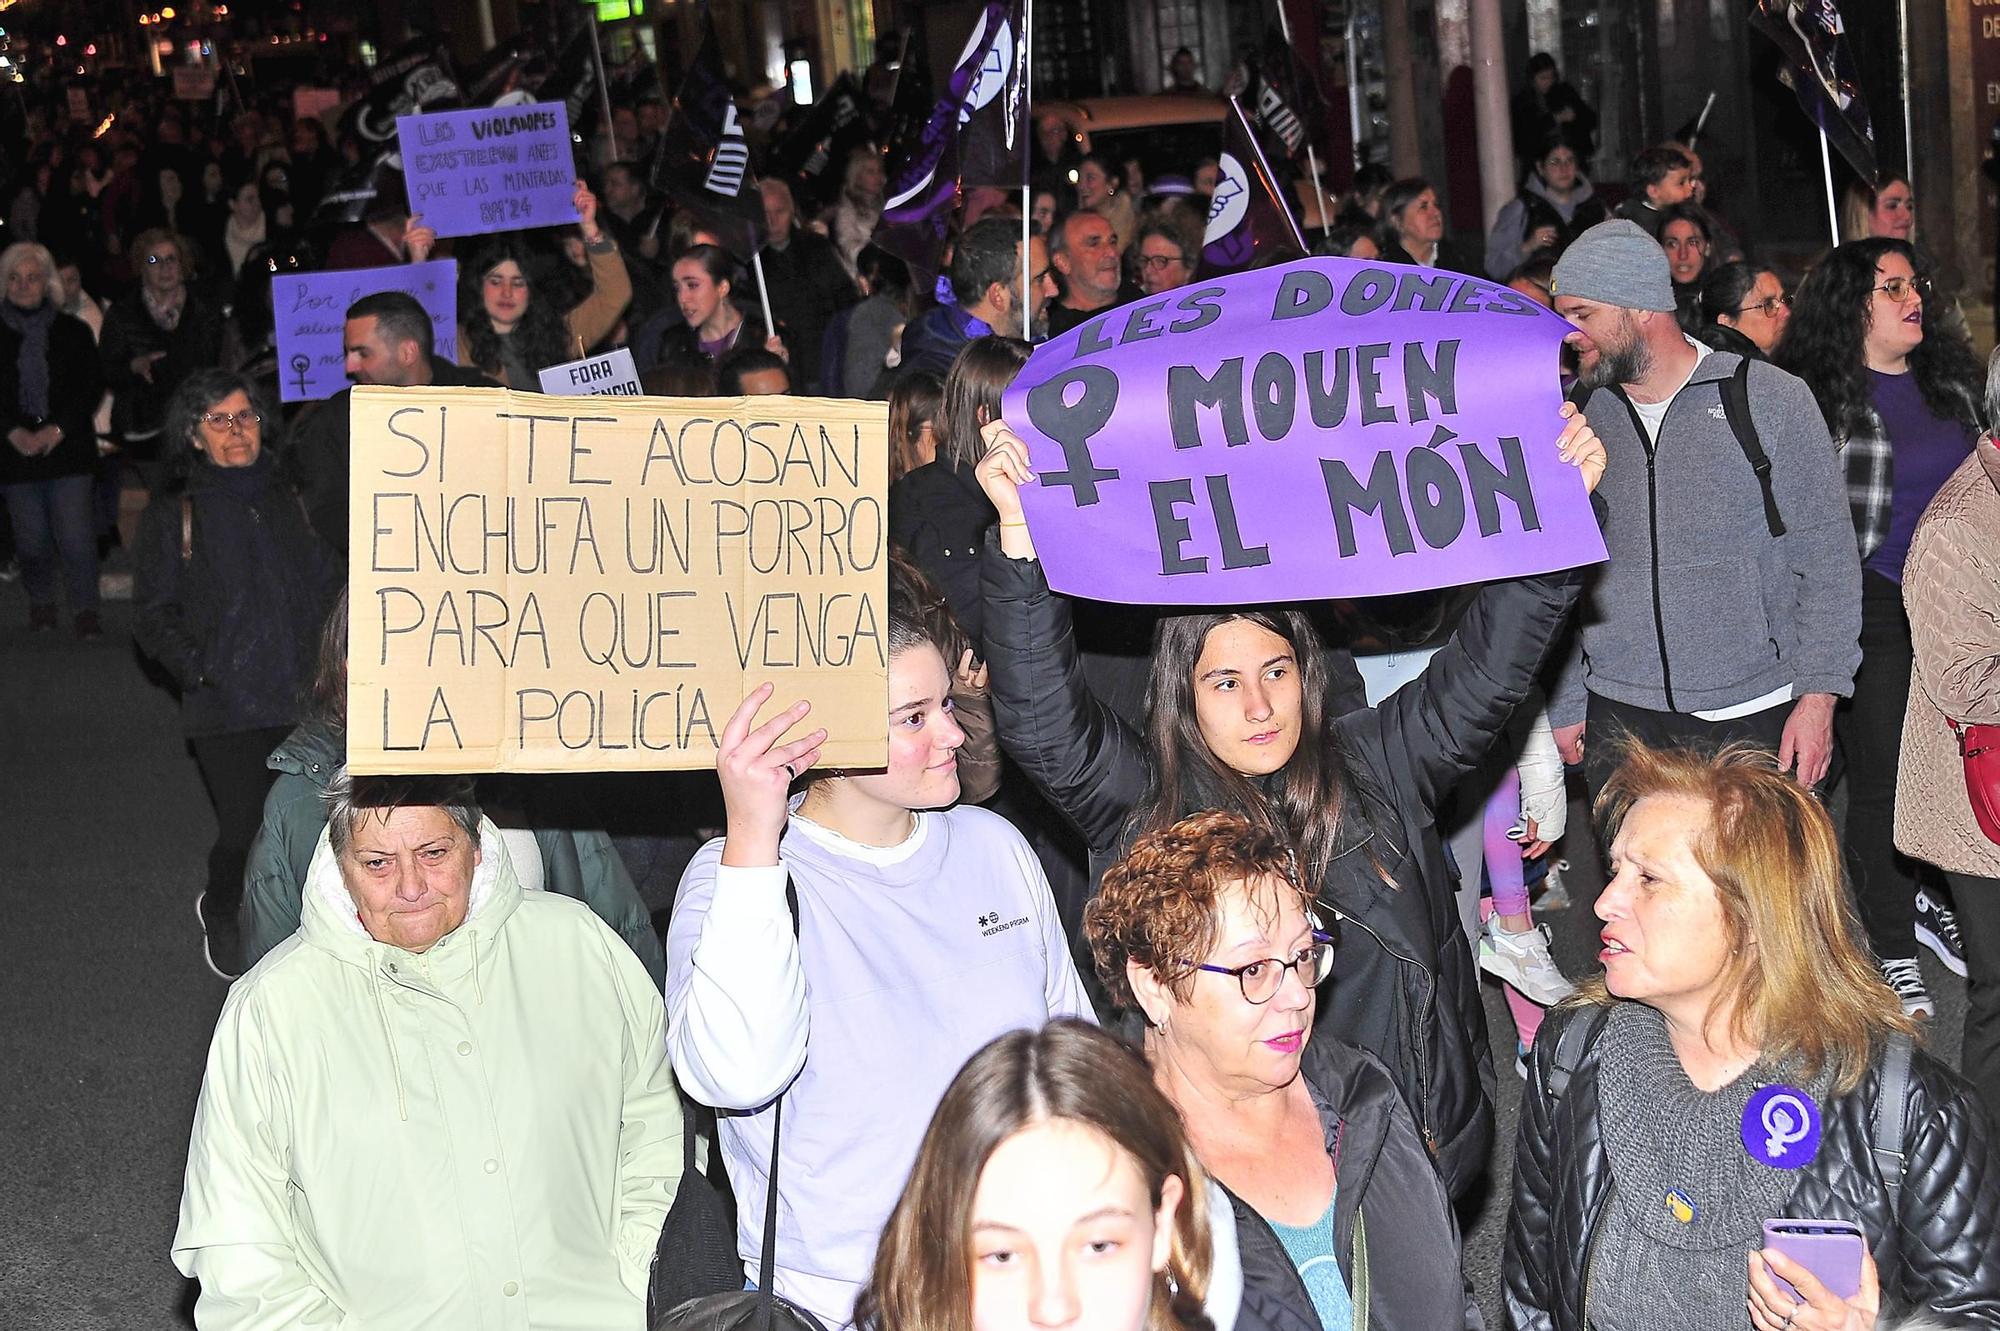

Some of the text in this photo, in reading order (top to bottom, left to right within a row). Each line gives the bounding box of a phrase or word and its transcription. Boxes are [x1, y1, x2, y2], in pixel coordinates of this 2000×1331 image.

[417, 170, 568, 200] QUE LAS MINIFALDAS
[1072, 268, 1540, 358] LES DONES
[569, 359, 614, 386] FORA
[1167, 340, 1461, 450] MOVEN
[382, 406, 859, 488] SI TE ACOSAN
[372, 492, 882, 576] ENCHUFA UN PORRO
[1148, 424, 1542, 576] EL MÓN
[376, 586, 886, 675] PARA QUE VENGA
[383, 686, 463, 751] LA
[981, 923, 1009, 937] WEEKEND
